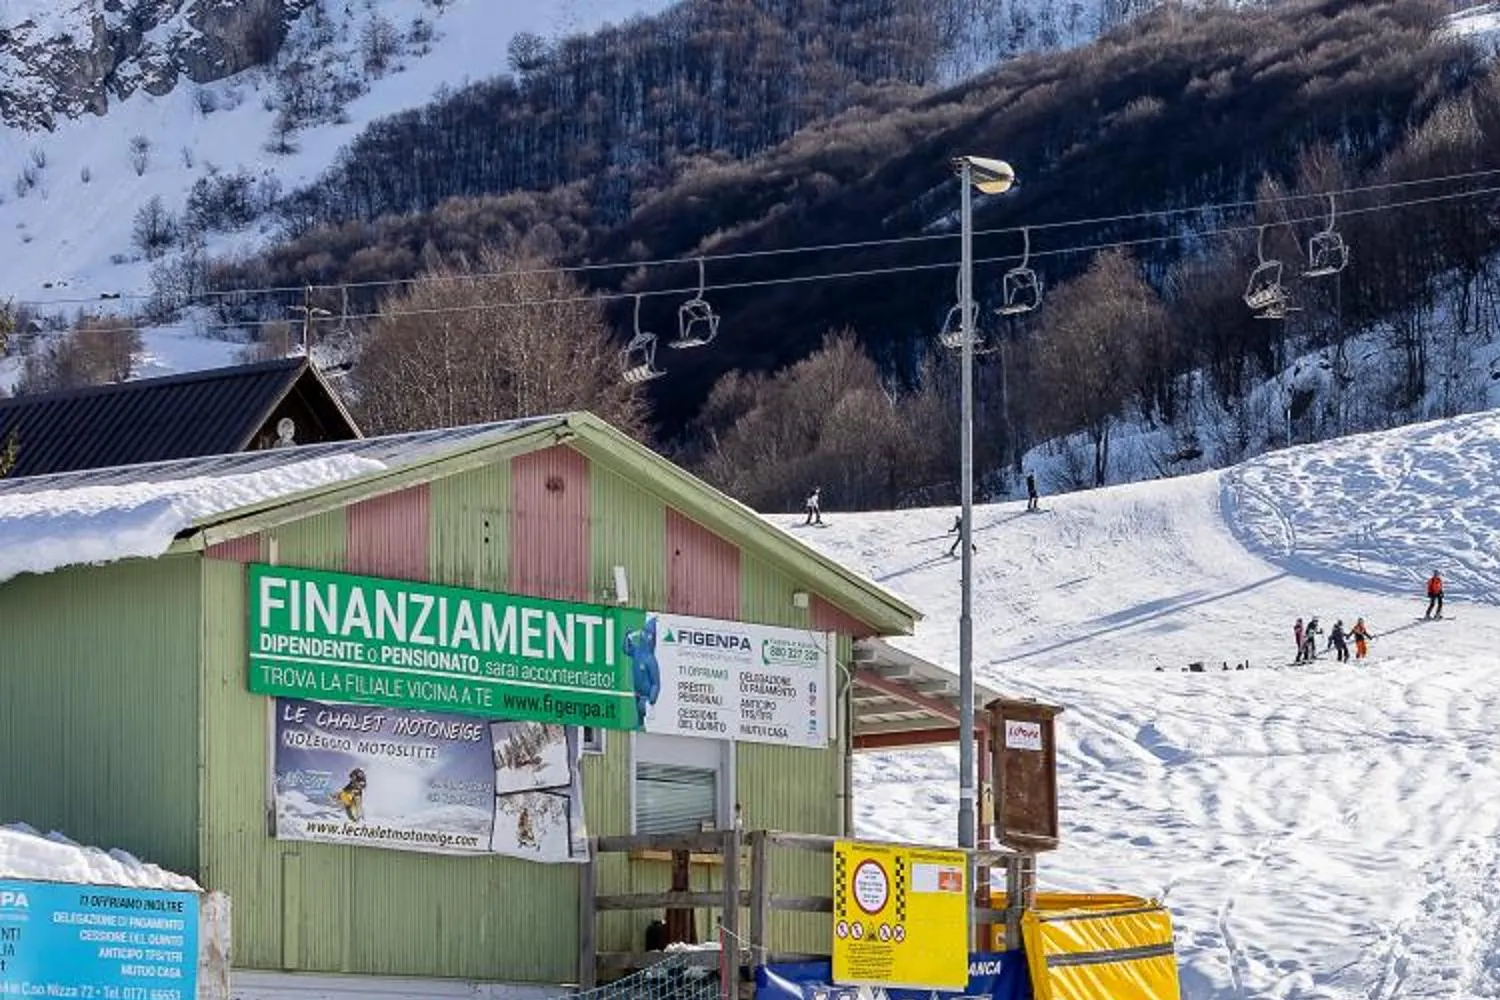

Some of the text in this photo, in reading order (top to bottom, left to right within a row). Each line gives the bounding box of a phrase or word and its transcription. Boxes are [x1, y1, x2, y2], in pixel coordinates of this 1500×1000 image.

[260, 575, 615, 666] FINANZIAMENTI
[677, 630, 752, 652] FIGENPA
[260, 633, 364, 661] DIPENDENTE
[486, 661, 519, 678] sarai
[521, 665, 616, 689] accontentato!
[260, 666, 616, 719] TROVA LA FILIALE VICINA A TE www.figenpa.it
[284, 705, 483, 743] LE CHALET MOTONEIGE
[768, 727, 788, 739] CASA
[284, 731, 439, 760] NOLEGGIO MOTOSLITTE
[157, 966, 182, 978] CASA
